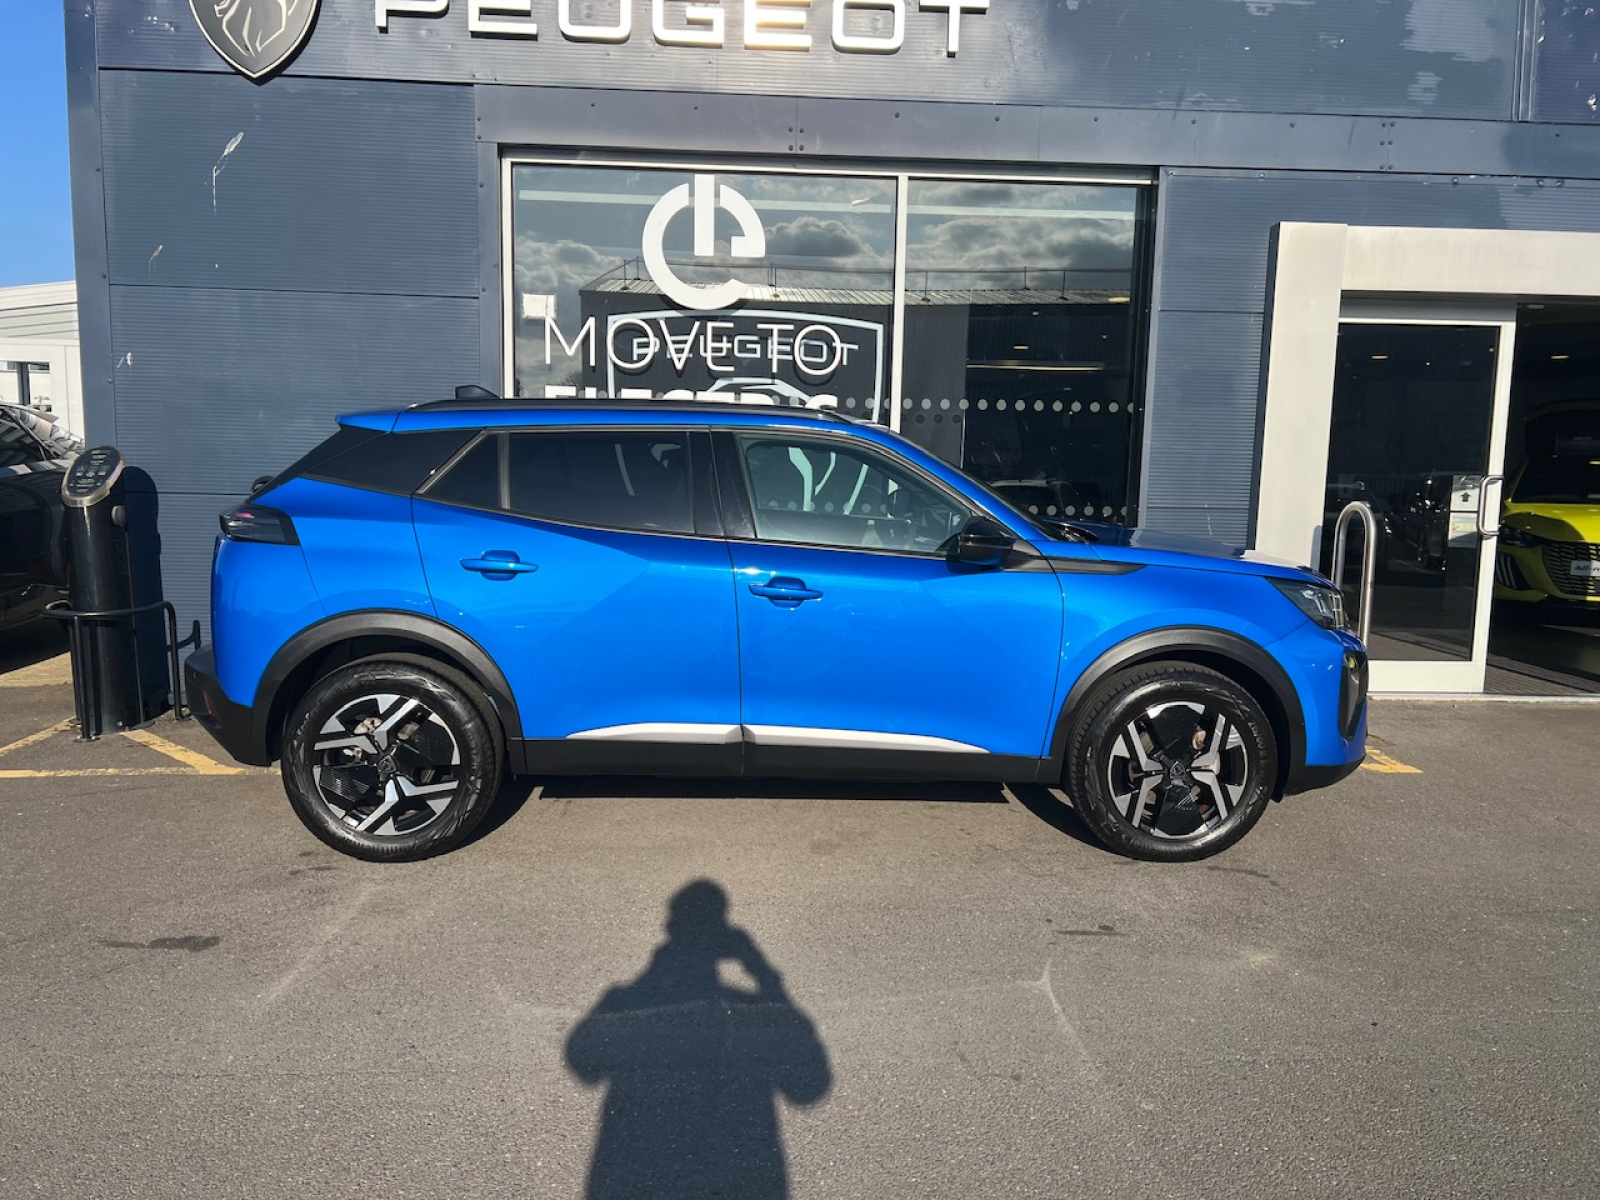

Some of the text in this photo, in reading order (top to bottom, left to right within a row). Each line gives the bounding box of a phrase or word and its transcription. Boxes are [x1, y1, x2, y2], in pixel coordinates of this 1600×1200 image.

[545, 315, 842, 376] MOVE TO
[632, 334, 859, 366] PEUGEOT
